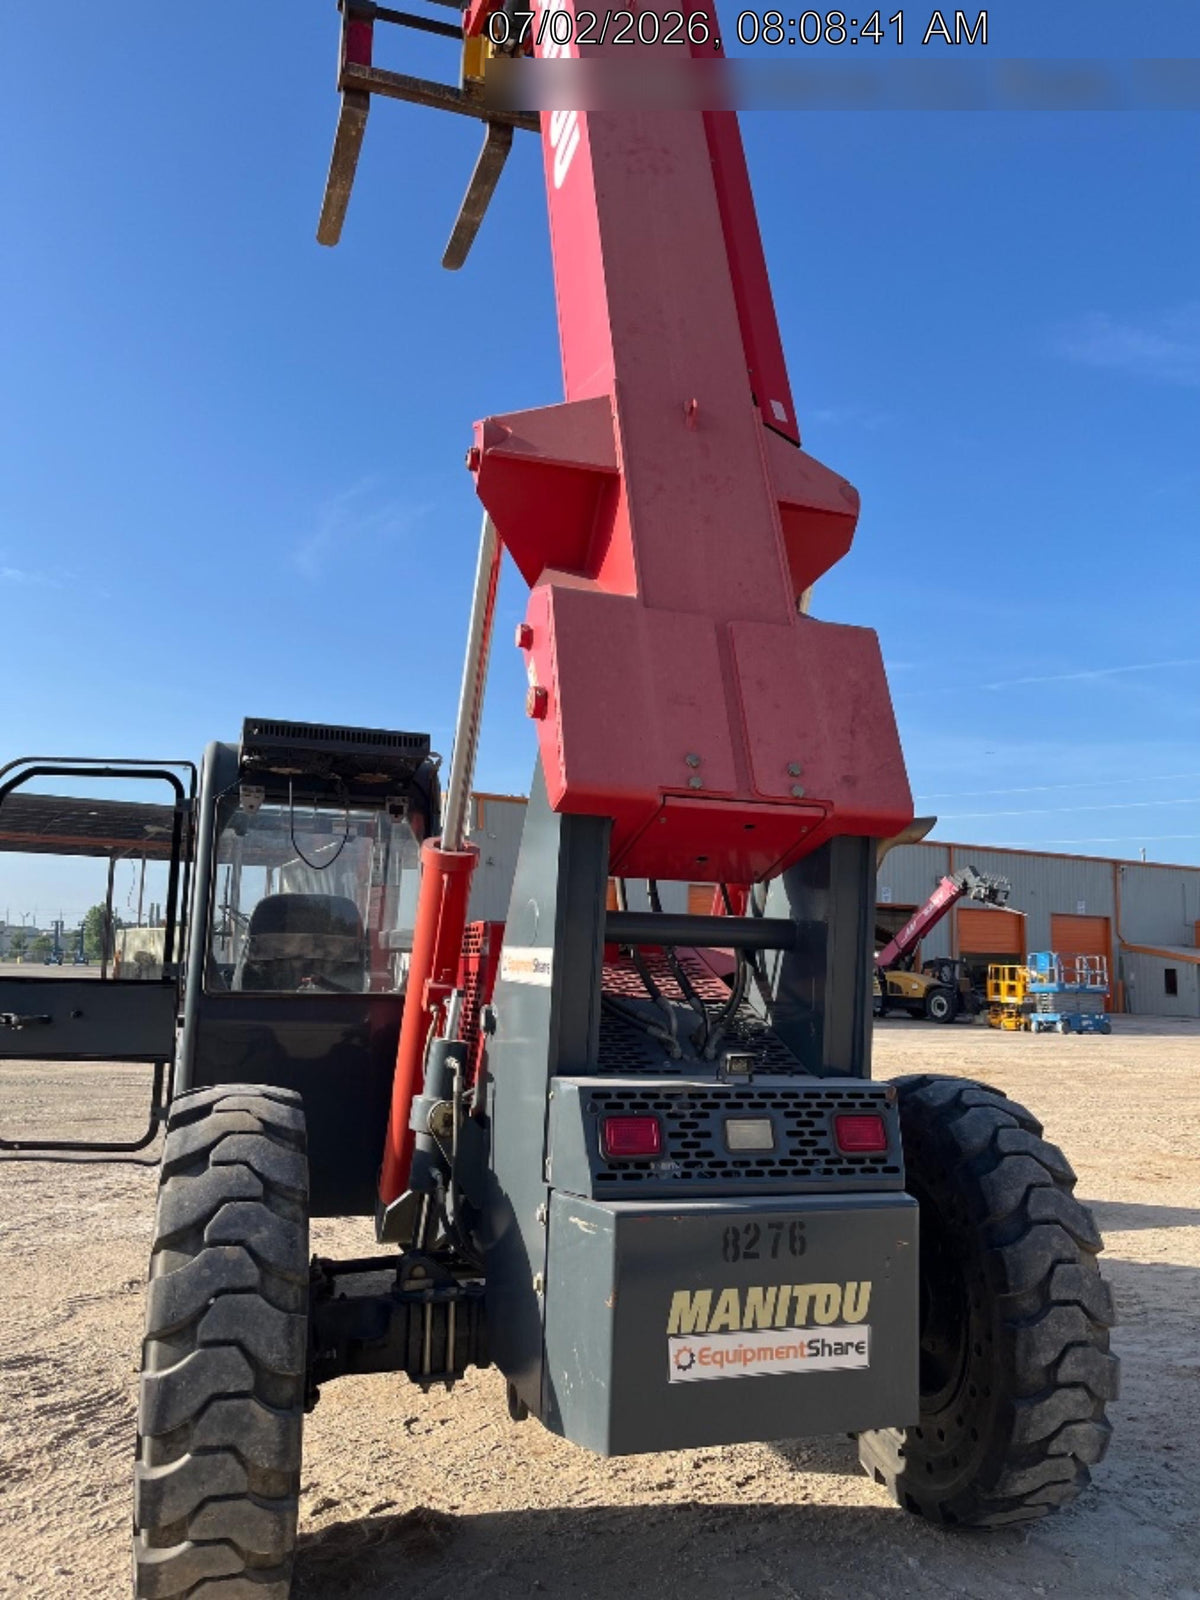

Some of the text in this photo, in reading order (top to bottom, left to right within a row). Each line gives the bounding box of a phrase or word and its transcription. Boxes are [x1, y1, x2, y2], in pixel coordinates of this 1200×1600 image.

[723, 1221, 807, 1263] 8276
[666, 1281, 872, 1335] MANITOU
[699, 1338, 866, 1370] EquipmentShare
